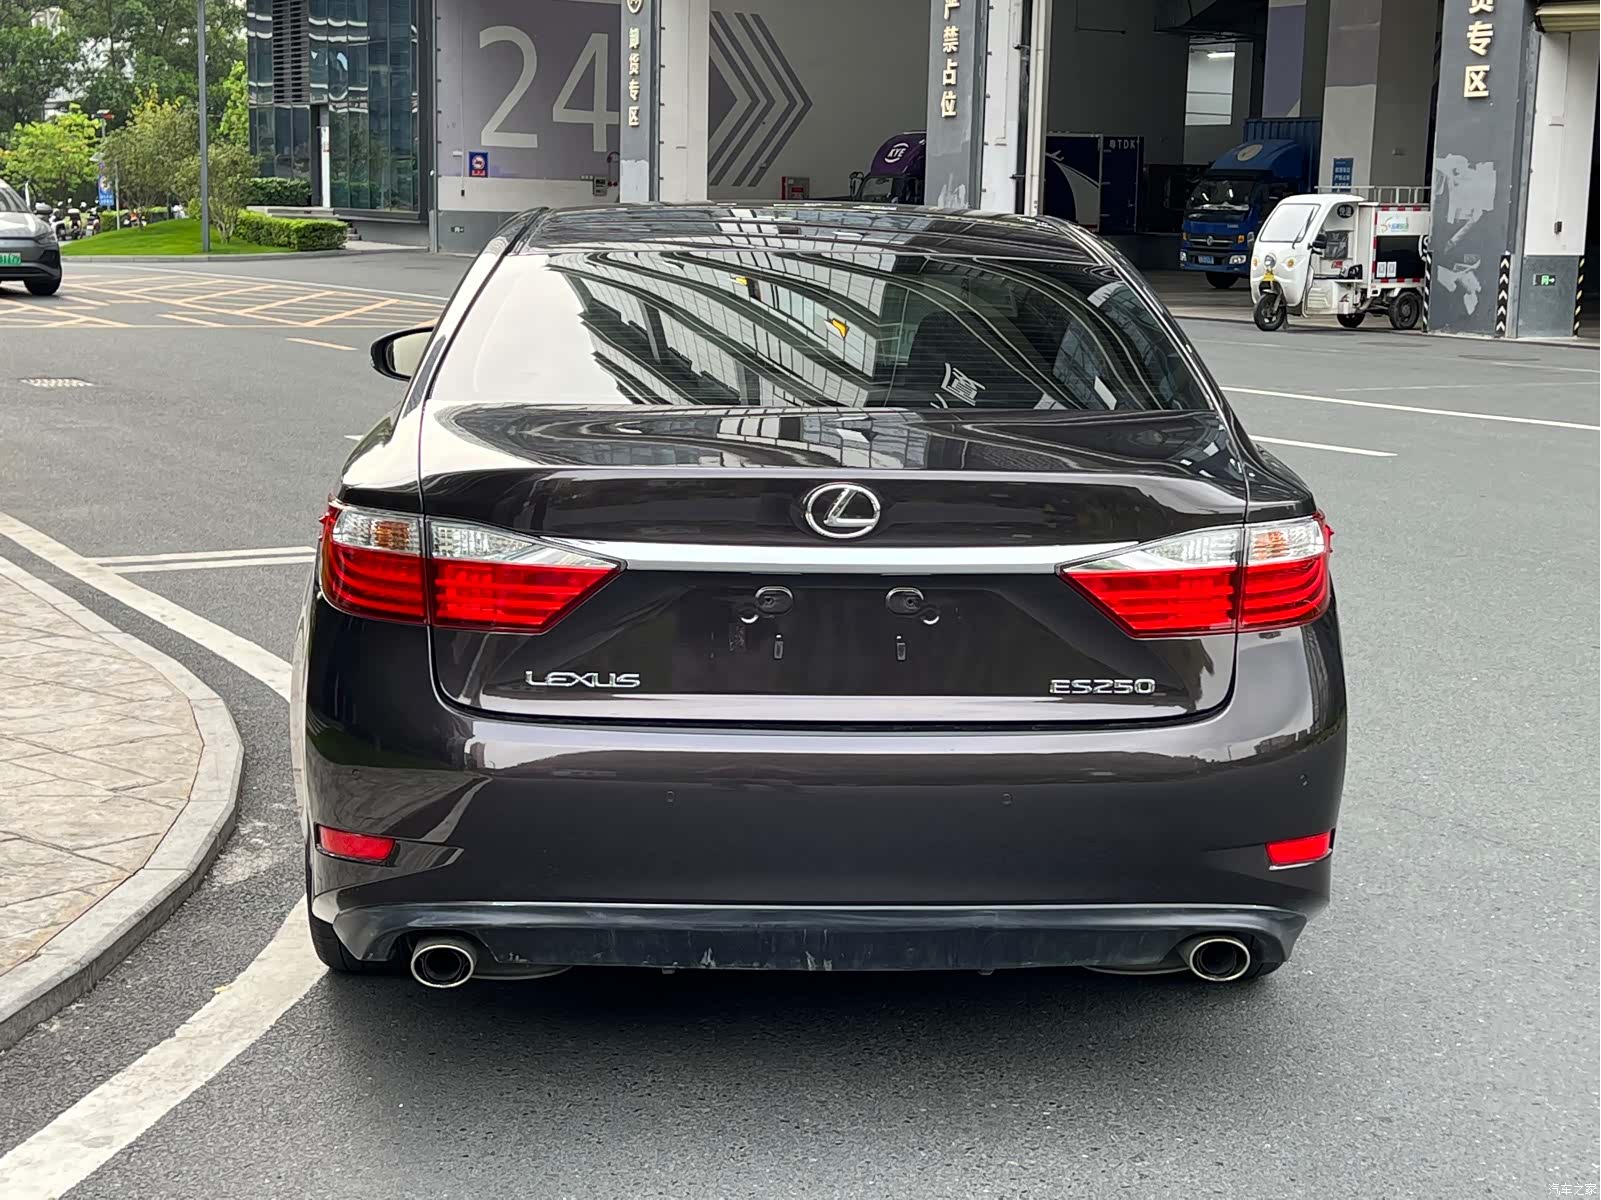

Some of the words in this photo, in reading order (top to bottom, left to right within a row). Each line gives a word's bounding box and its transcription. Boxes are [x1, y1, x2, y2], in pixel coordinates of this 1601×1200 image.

[479, 25, 620, 152] 24
[525, 670, 641, 688] LEXUS
[1049, 678, 1156, 694] ES250
